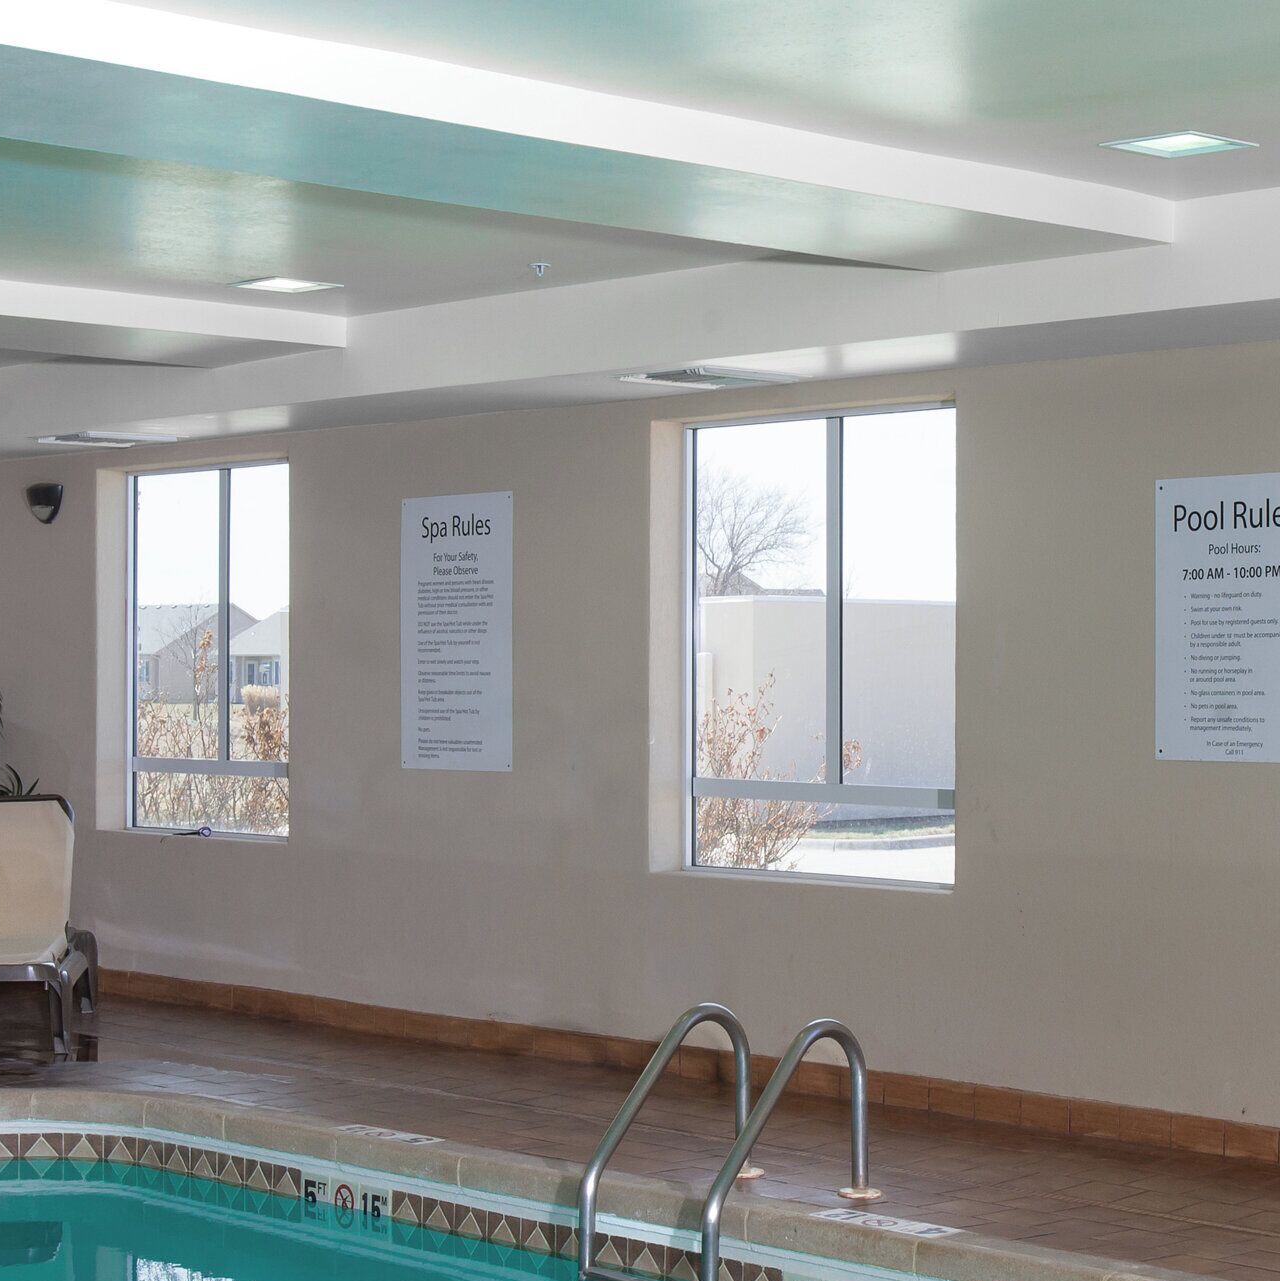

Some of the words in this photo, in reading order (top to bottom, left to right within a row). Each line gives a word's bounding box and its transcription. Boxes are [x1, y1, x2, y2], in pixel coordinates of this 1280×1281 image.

[1173, 501, 1224, 532] Pool
[422, 516, 447, 543] Spa
[453, 514, 491, 536] Rules
[1209, 543, 1229, 555] Pool
[1231, 542, 1261, 554] Hours:
[433, 553, 442, 562] For
[444, 553, 456, 562] Your
[458, 551, 478, 563] Safety,
[433, 566, 452, 575] Please
[453, 565, 478, 575] Observe
[1183, 568, 1204, 581] 7:00
[1207, 568, 1224, 579] AM
[1234, 566, 1262, 579] 10:00
[304, 1179, 316, 1203] 5
[318, 1182, 326, 1195] FT
